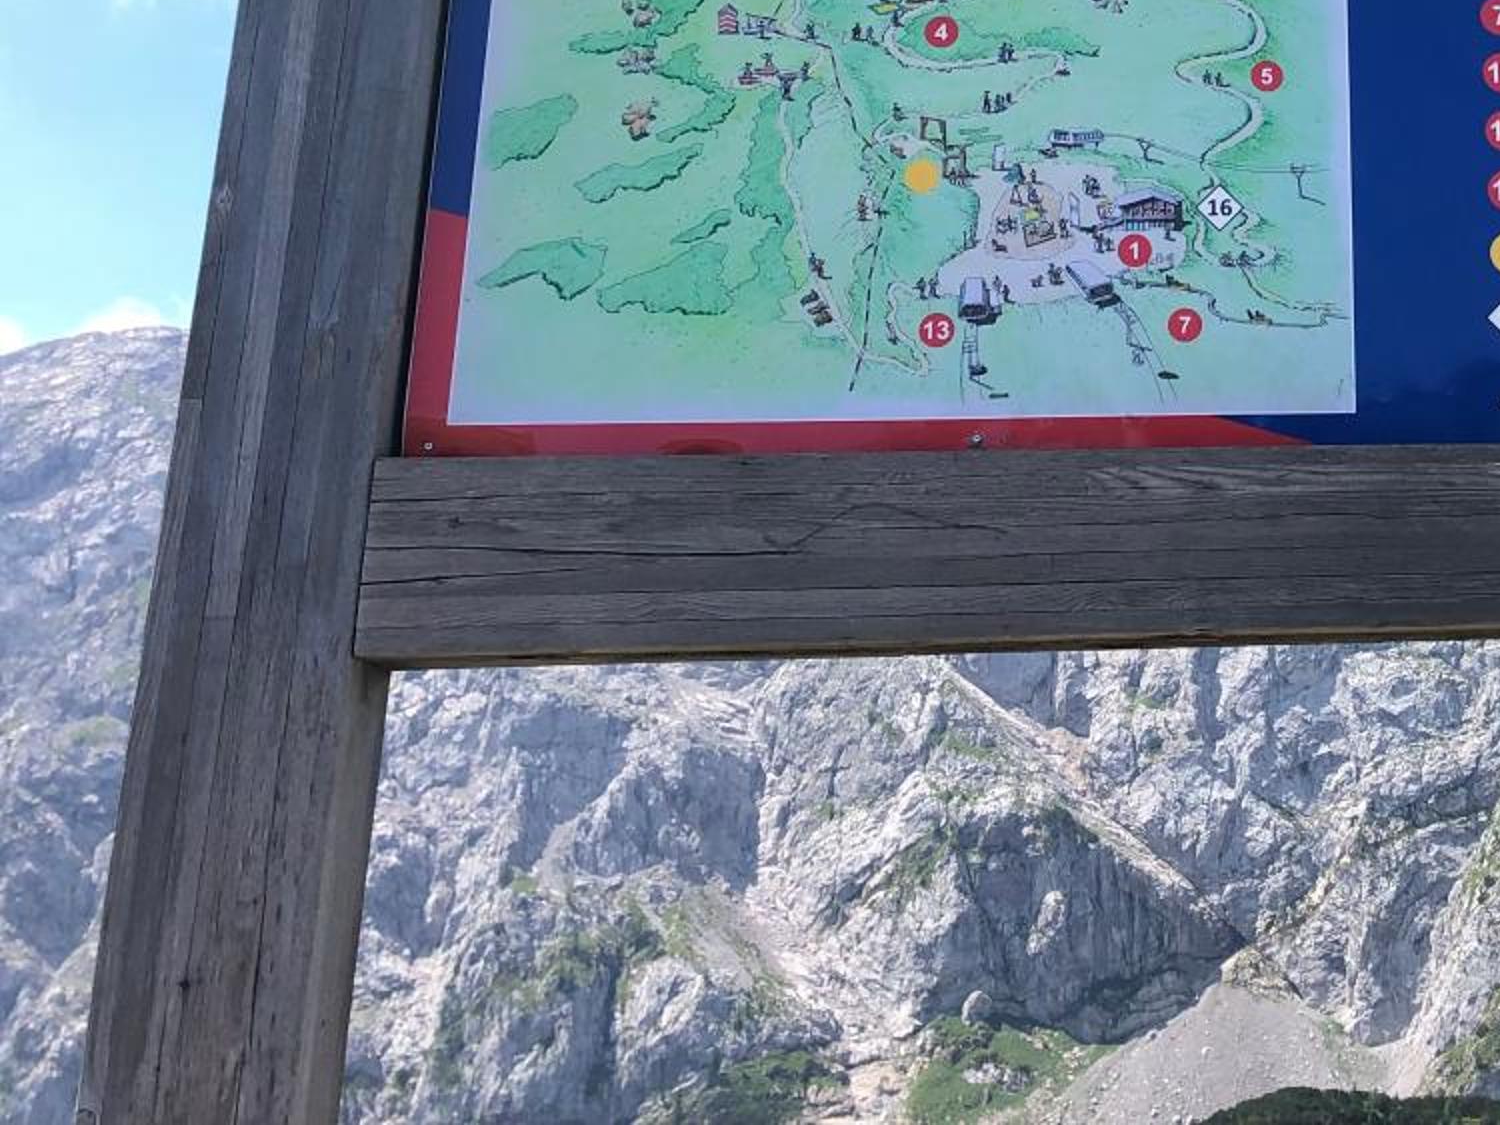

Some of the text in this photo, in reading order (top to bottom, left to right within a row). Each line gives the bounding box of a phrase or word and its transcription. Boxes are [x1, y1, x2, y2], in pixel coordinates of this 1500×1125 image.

[935, 23, 949, 41] 4
[1260, 68, 1273, 86] 5
[1207, 198, 1233, 216] 16
[1129, 241, 1139, 261] 1
[923, 321, 949, 340] 13
[1177, 315, 1192, 335] 7
